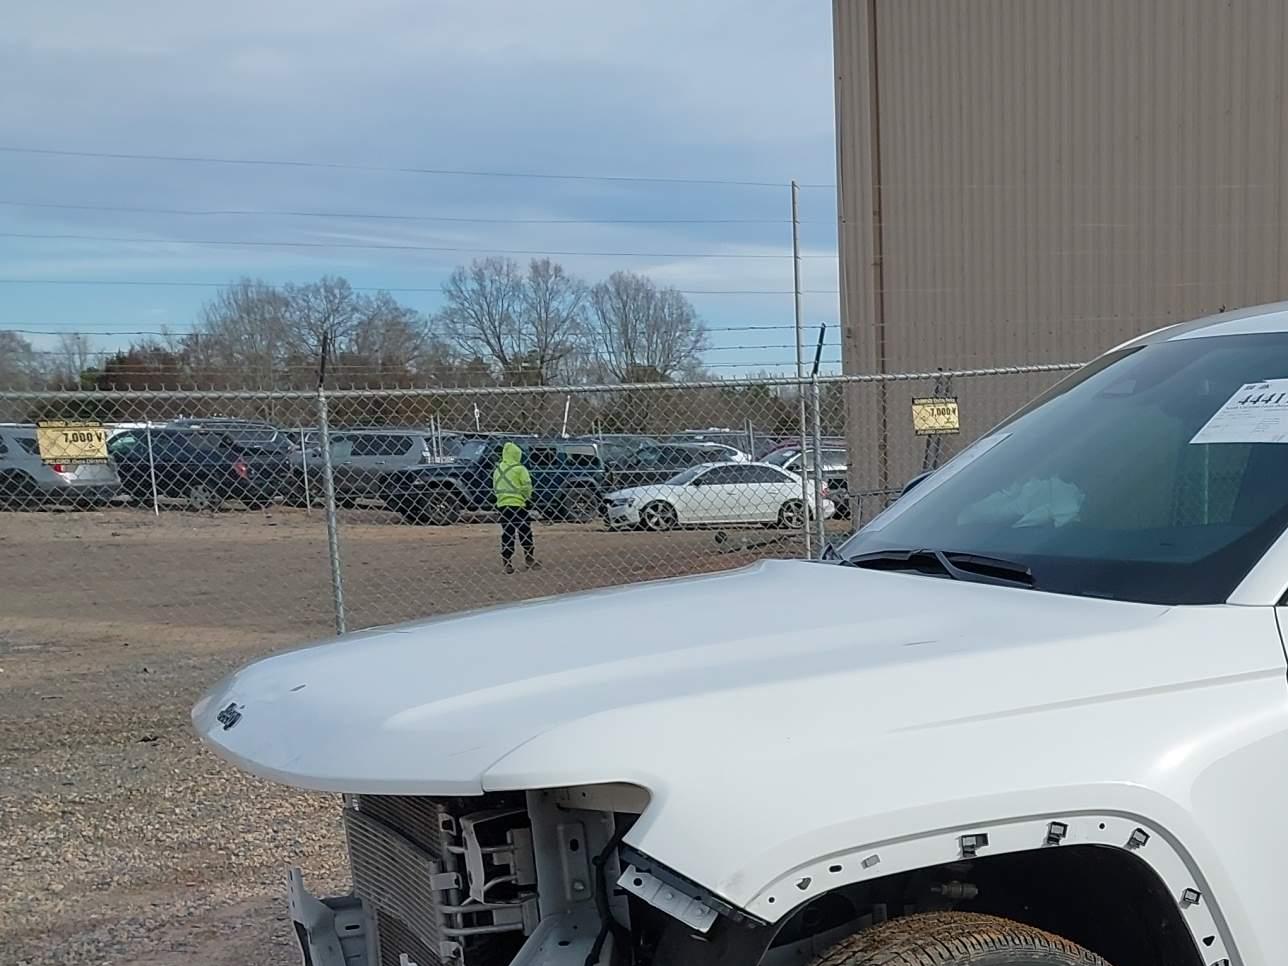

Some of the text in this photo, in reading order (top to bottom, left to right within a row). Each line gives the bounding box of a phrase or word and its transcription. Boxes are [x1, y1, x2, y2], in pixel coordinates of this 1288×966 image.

[930, 408, 951, 417] 7,000
[62, 432, 102, 443] 7,000 V
